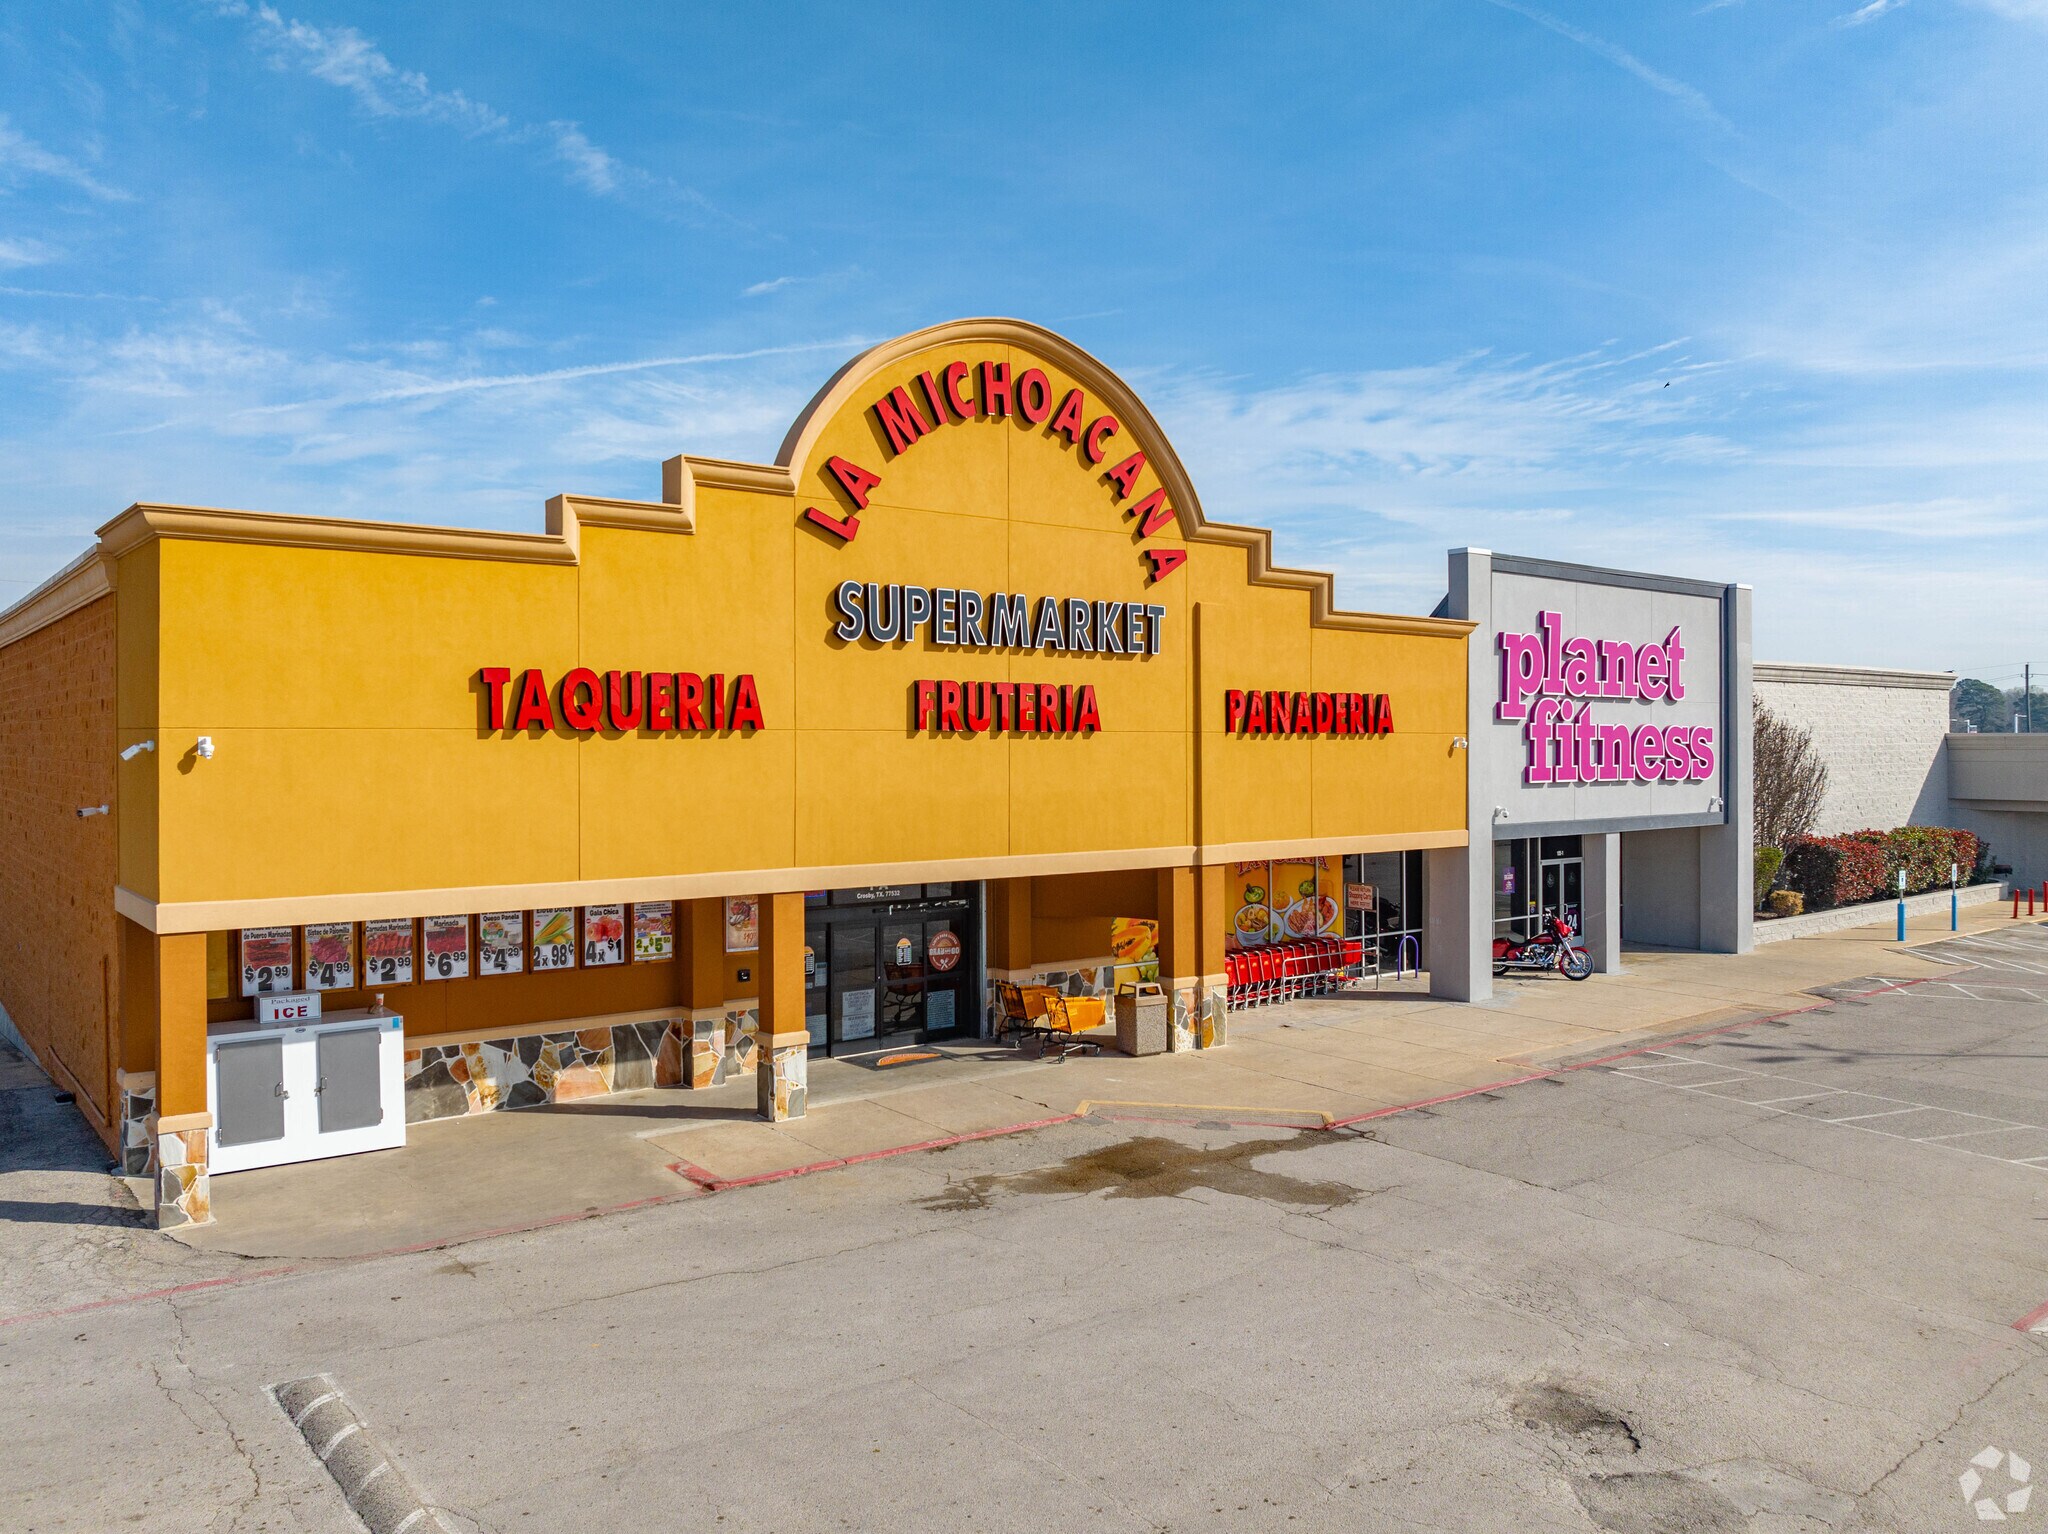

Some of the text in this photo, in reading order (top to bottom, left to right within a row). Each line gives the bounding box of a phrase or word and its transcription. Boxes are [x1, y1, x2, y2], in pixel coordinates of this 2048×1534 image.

[804, 361, 1187, 582] LA MICHOACANA
[835, 580, 1166, 655] SUPERMARKET
[1496, 610, 1686, 720] planet
[480, 667, 765, 732] TAQUERIA
[914, 680, 1101, 732] FRUTERIA
[1225, 689, 1395, 734] PANADERIA
[1525, 697, 1715, 783] fitness
[534, 946, 540, 966] 2
[542, 957, 548, 966] x
[586, 941, 596, 962] 4
[608, 938, 622, 960] $1
[271, 996, 310, 1005] Packaged
[274, 1006, 308, 1020] ICE
